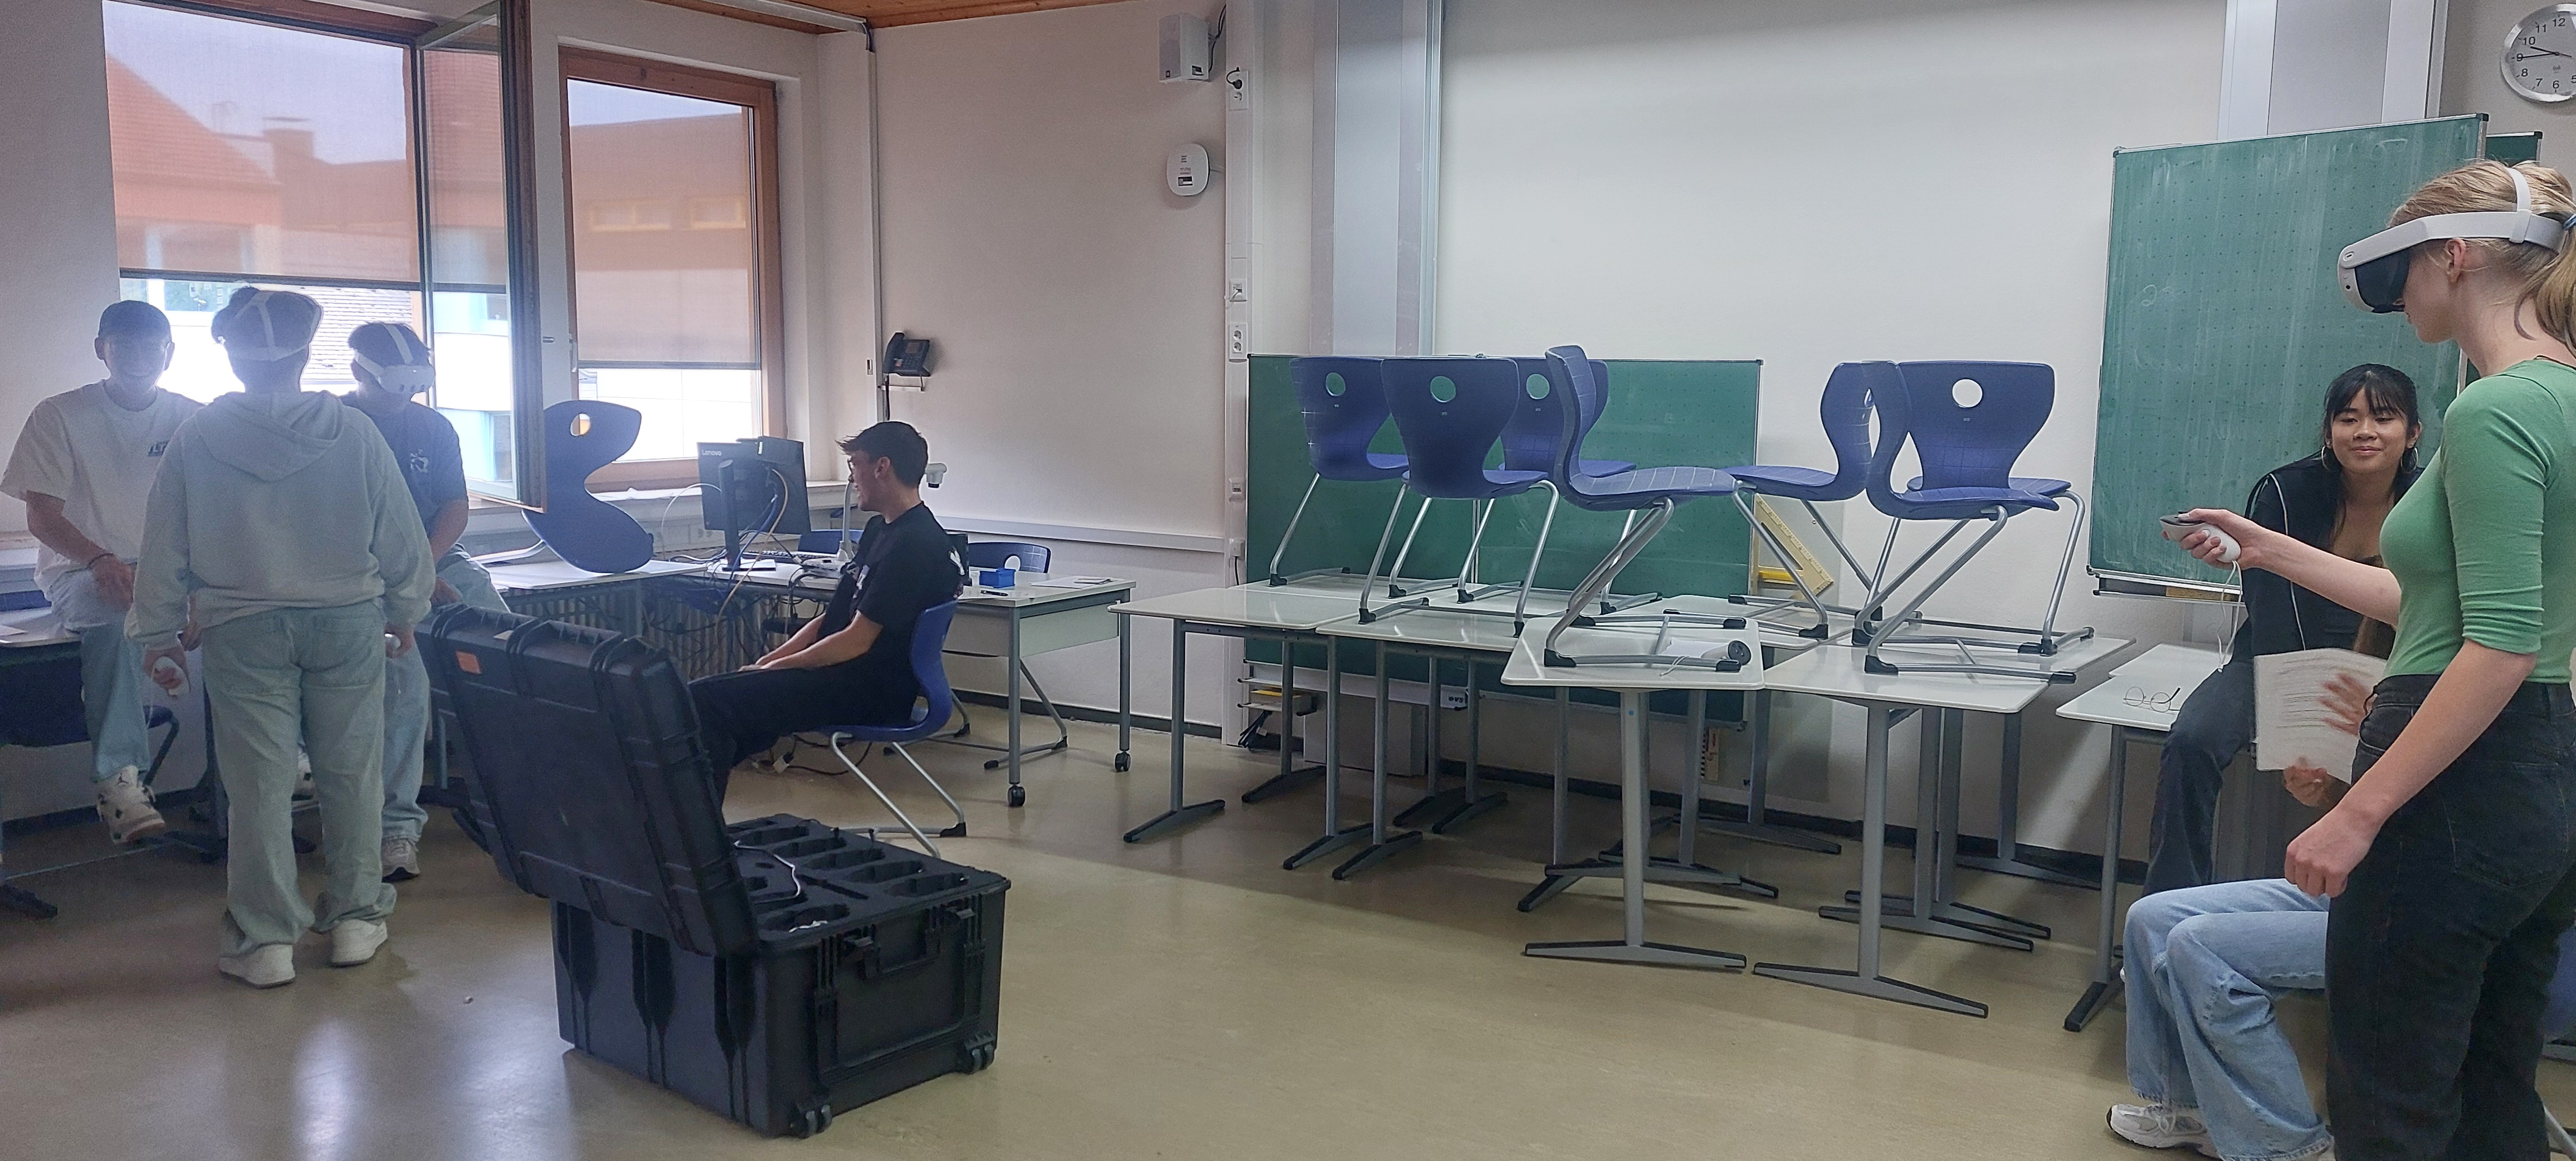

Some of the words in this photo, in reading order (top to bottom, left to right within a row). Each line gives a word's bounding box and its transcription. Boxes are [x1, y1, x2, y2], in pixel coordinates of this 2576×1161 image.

[2553, 18, 2565, 27] 12
[2535, 25, 2546, 33] 11
[2523, 36, 2535, 45] 10
[2521, 69, 2528, 77] 8
[2536, 78, 2543, 86] 7
[2571, 75, 2576, 84] 5
[2553, 80, 2559, 89] 6
